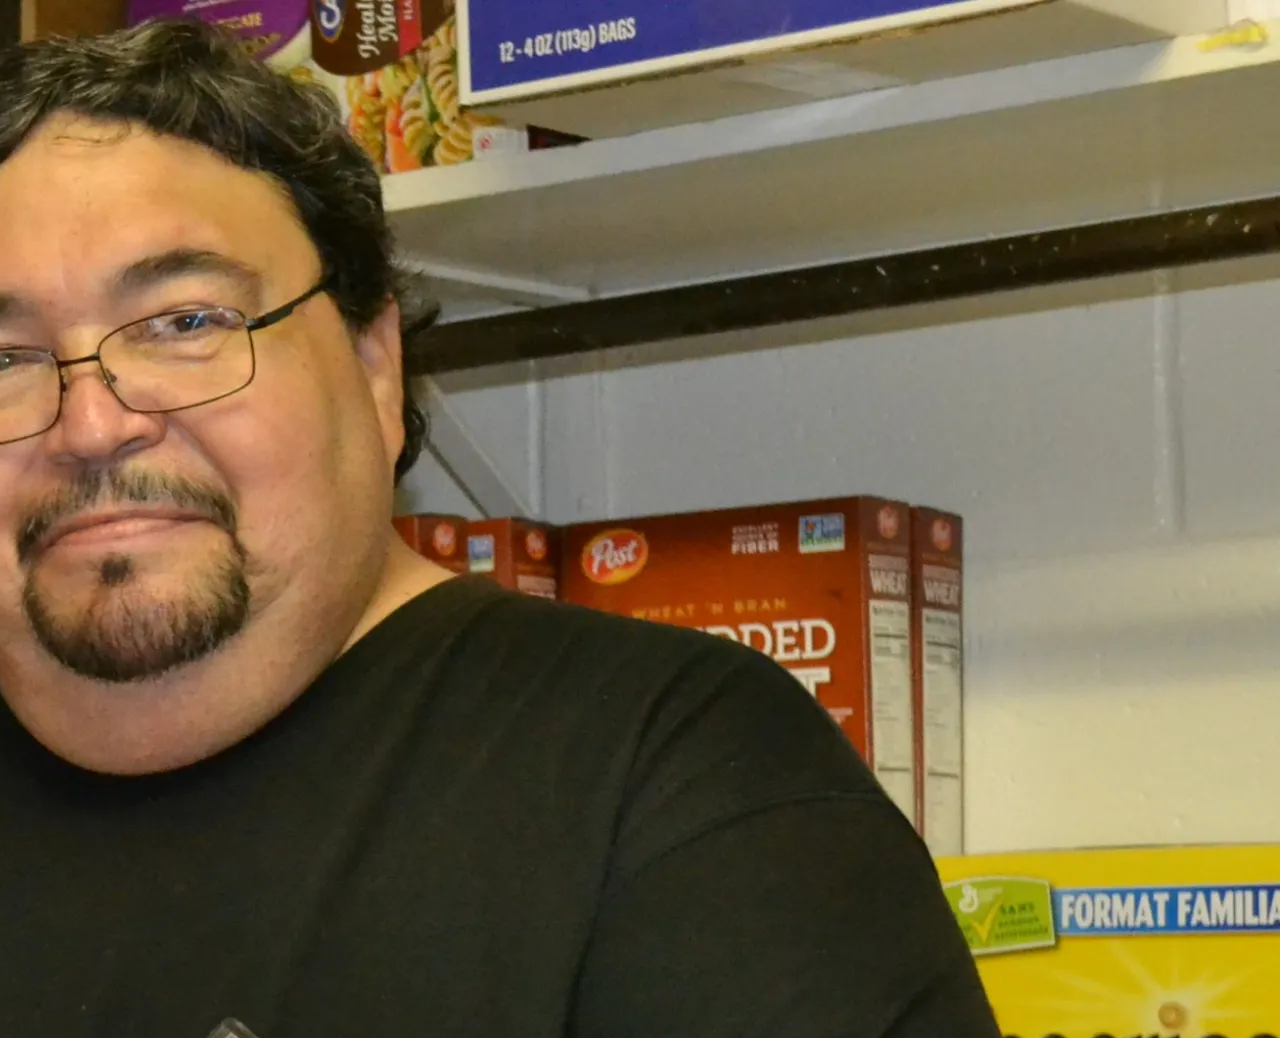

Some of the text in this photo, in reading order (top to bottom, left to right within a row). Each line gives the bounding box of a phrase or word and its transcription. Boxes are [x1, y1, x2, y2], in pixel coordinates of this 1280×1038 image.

[355, 0, 380, 58] Heal
[555, 24, 597, 55] (113g)
[598, 16, 637, 45] BAGS
[591, 537, 639, 575] Post
[734, 598, 787, 614] BRAN
[1061, 893, 1170, 929] FORMAT
